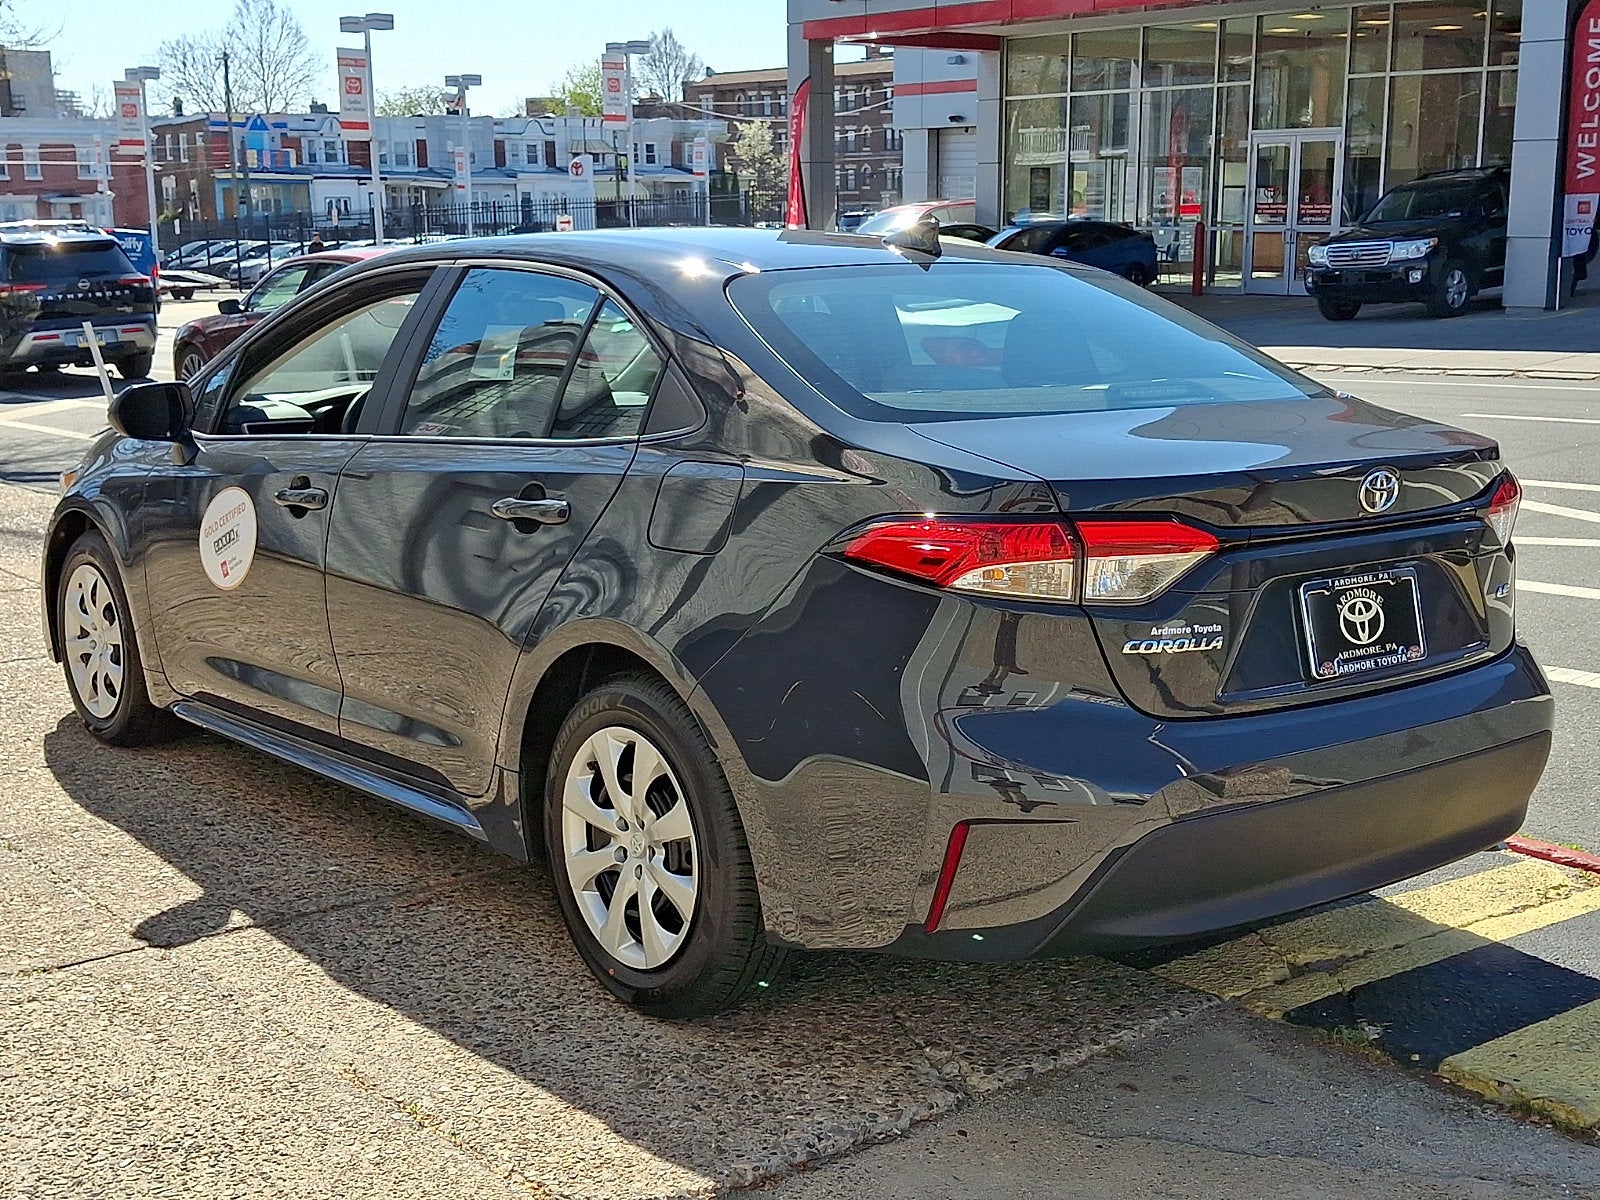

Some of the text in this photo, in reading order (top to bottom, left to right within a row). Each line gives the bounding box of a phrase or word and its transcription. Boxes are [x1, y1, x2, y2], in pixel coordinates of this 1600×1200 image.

[1576, 17, 1600, 179] WELCOME
[1565, 226, 1593, 236] TOYO
[36, 289, 131, 301] PATHFINDER
[204, 502, 246, 538] GOLD CERTIFIED
[1378, 572, 1389, 580] PA
[1336, 587, 1384, 614] ARDMORE
[1150, 624, 1222, 636] Ardmore Toyota
[1121, 636, 1224, 654] COROLLA
[1386, 642, 1398, 651] PA
[1338, 653, 1408, 674] ARDMORE TOYOTA
